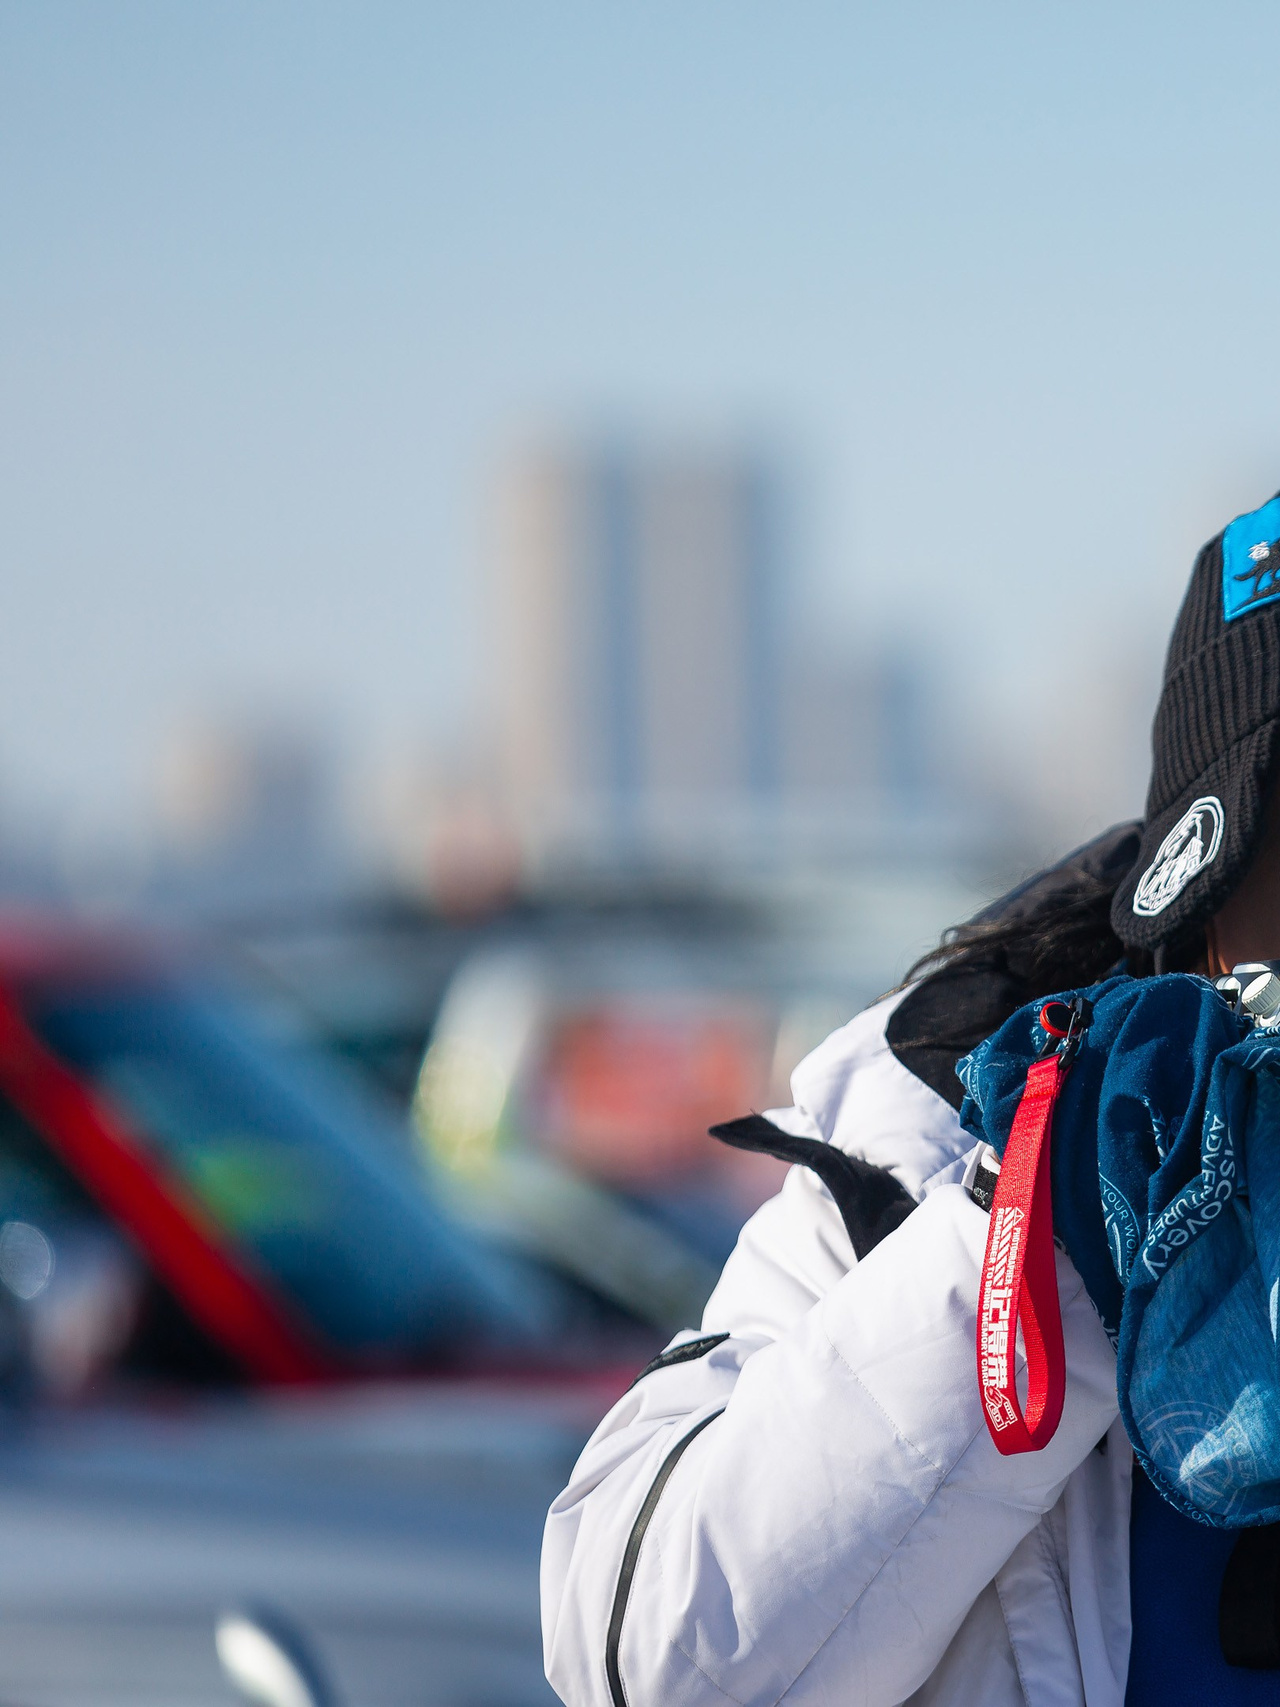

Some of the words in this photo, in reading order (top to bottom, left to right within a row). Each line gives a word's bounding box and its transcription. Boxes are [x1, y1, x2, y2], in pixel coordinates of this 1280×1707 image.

[1102, 1184, 1129, 1221] YOUR
[988, 1208, 1004, 1265] REMEMBER
[1004, 1227, 1021, 1285] PHOTOGRAPHER
[985, 1265, 996, 1280] TO
[983, 1280, 993, 1310] BRING
[980, 1312, 989, 1356] MEMORY
[986, 1286, 1013, 1390] 记得带
[980, 1359, 990, 1387] CARD
